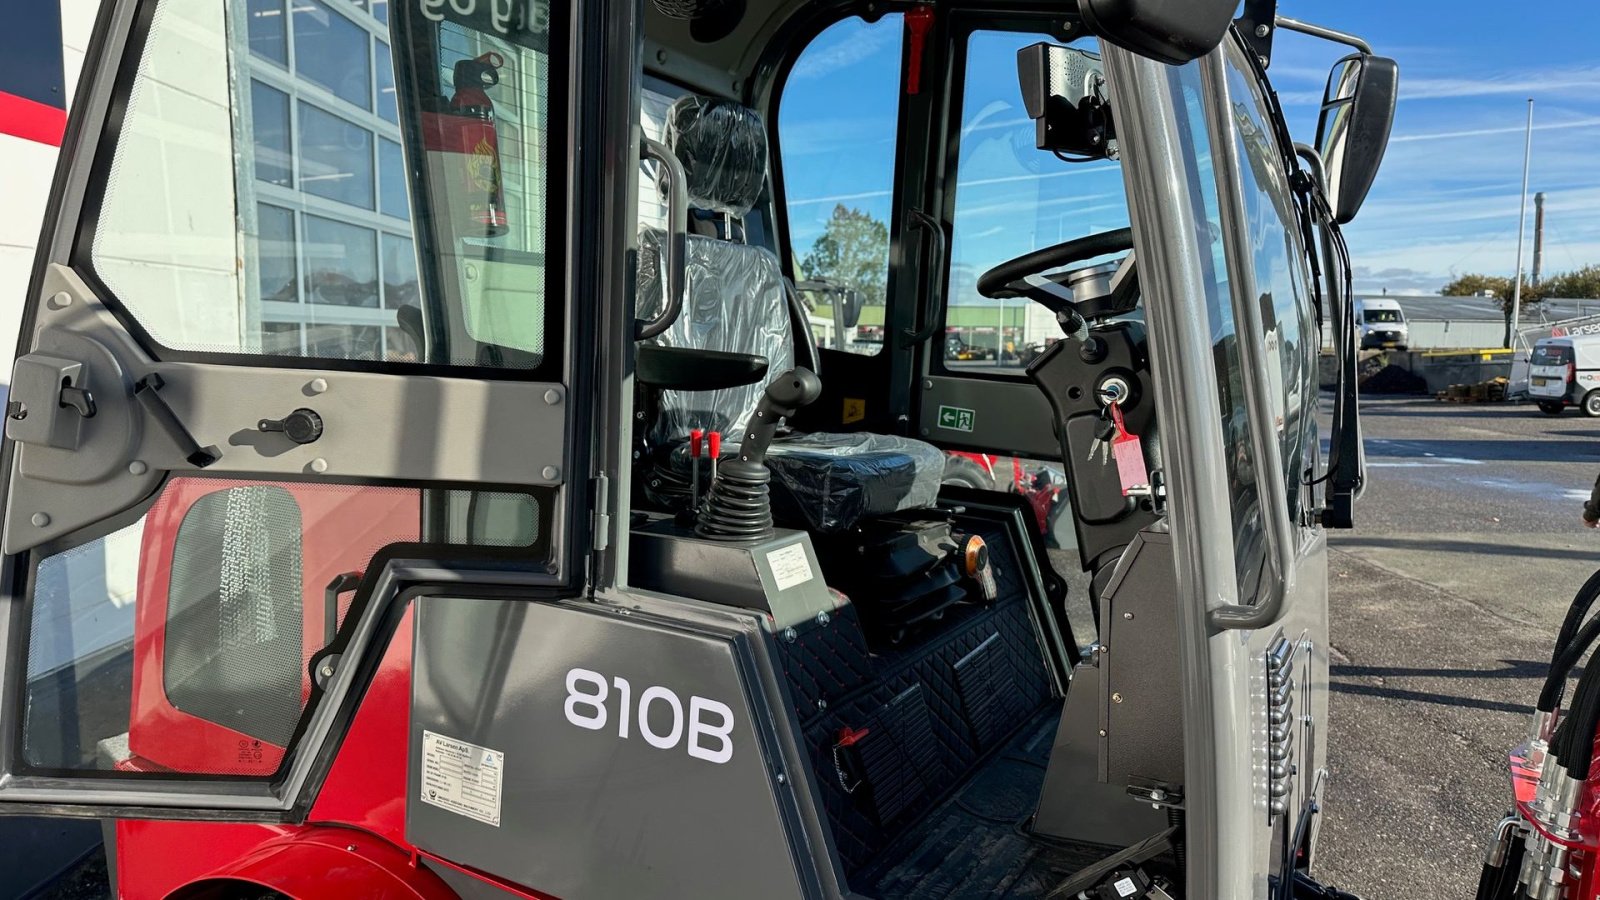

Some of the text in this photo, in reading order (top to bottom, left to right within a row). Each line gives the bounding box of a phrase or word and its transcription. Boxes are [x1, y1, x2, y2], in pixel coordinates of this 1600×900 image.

[1565, 323, 1600, 336] Larse
[564, 668, 734, 764] 810B
[443, 740, 459, 750] Larsen
